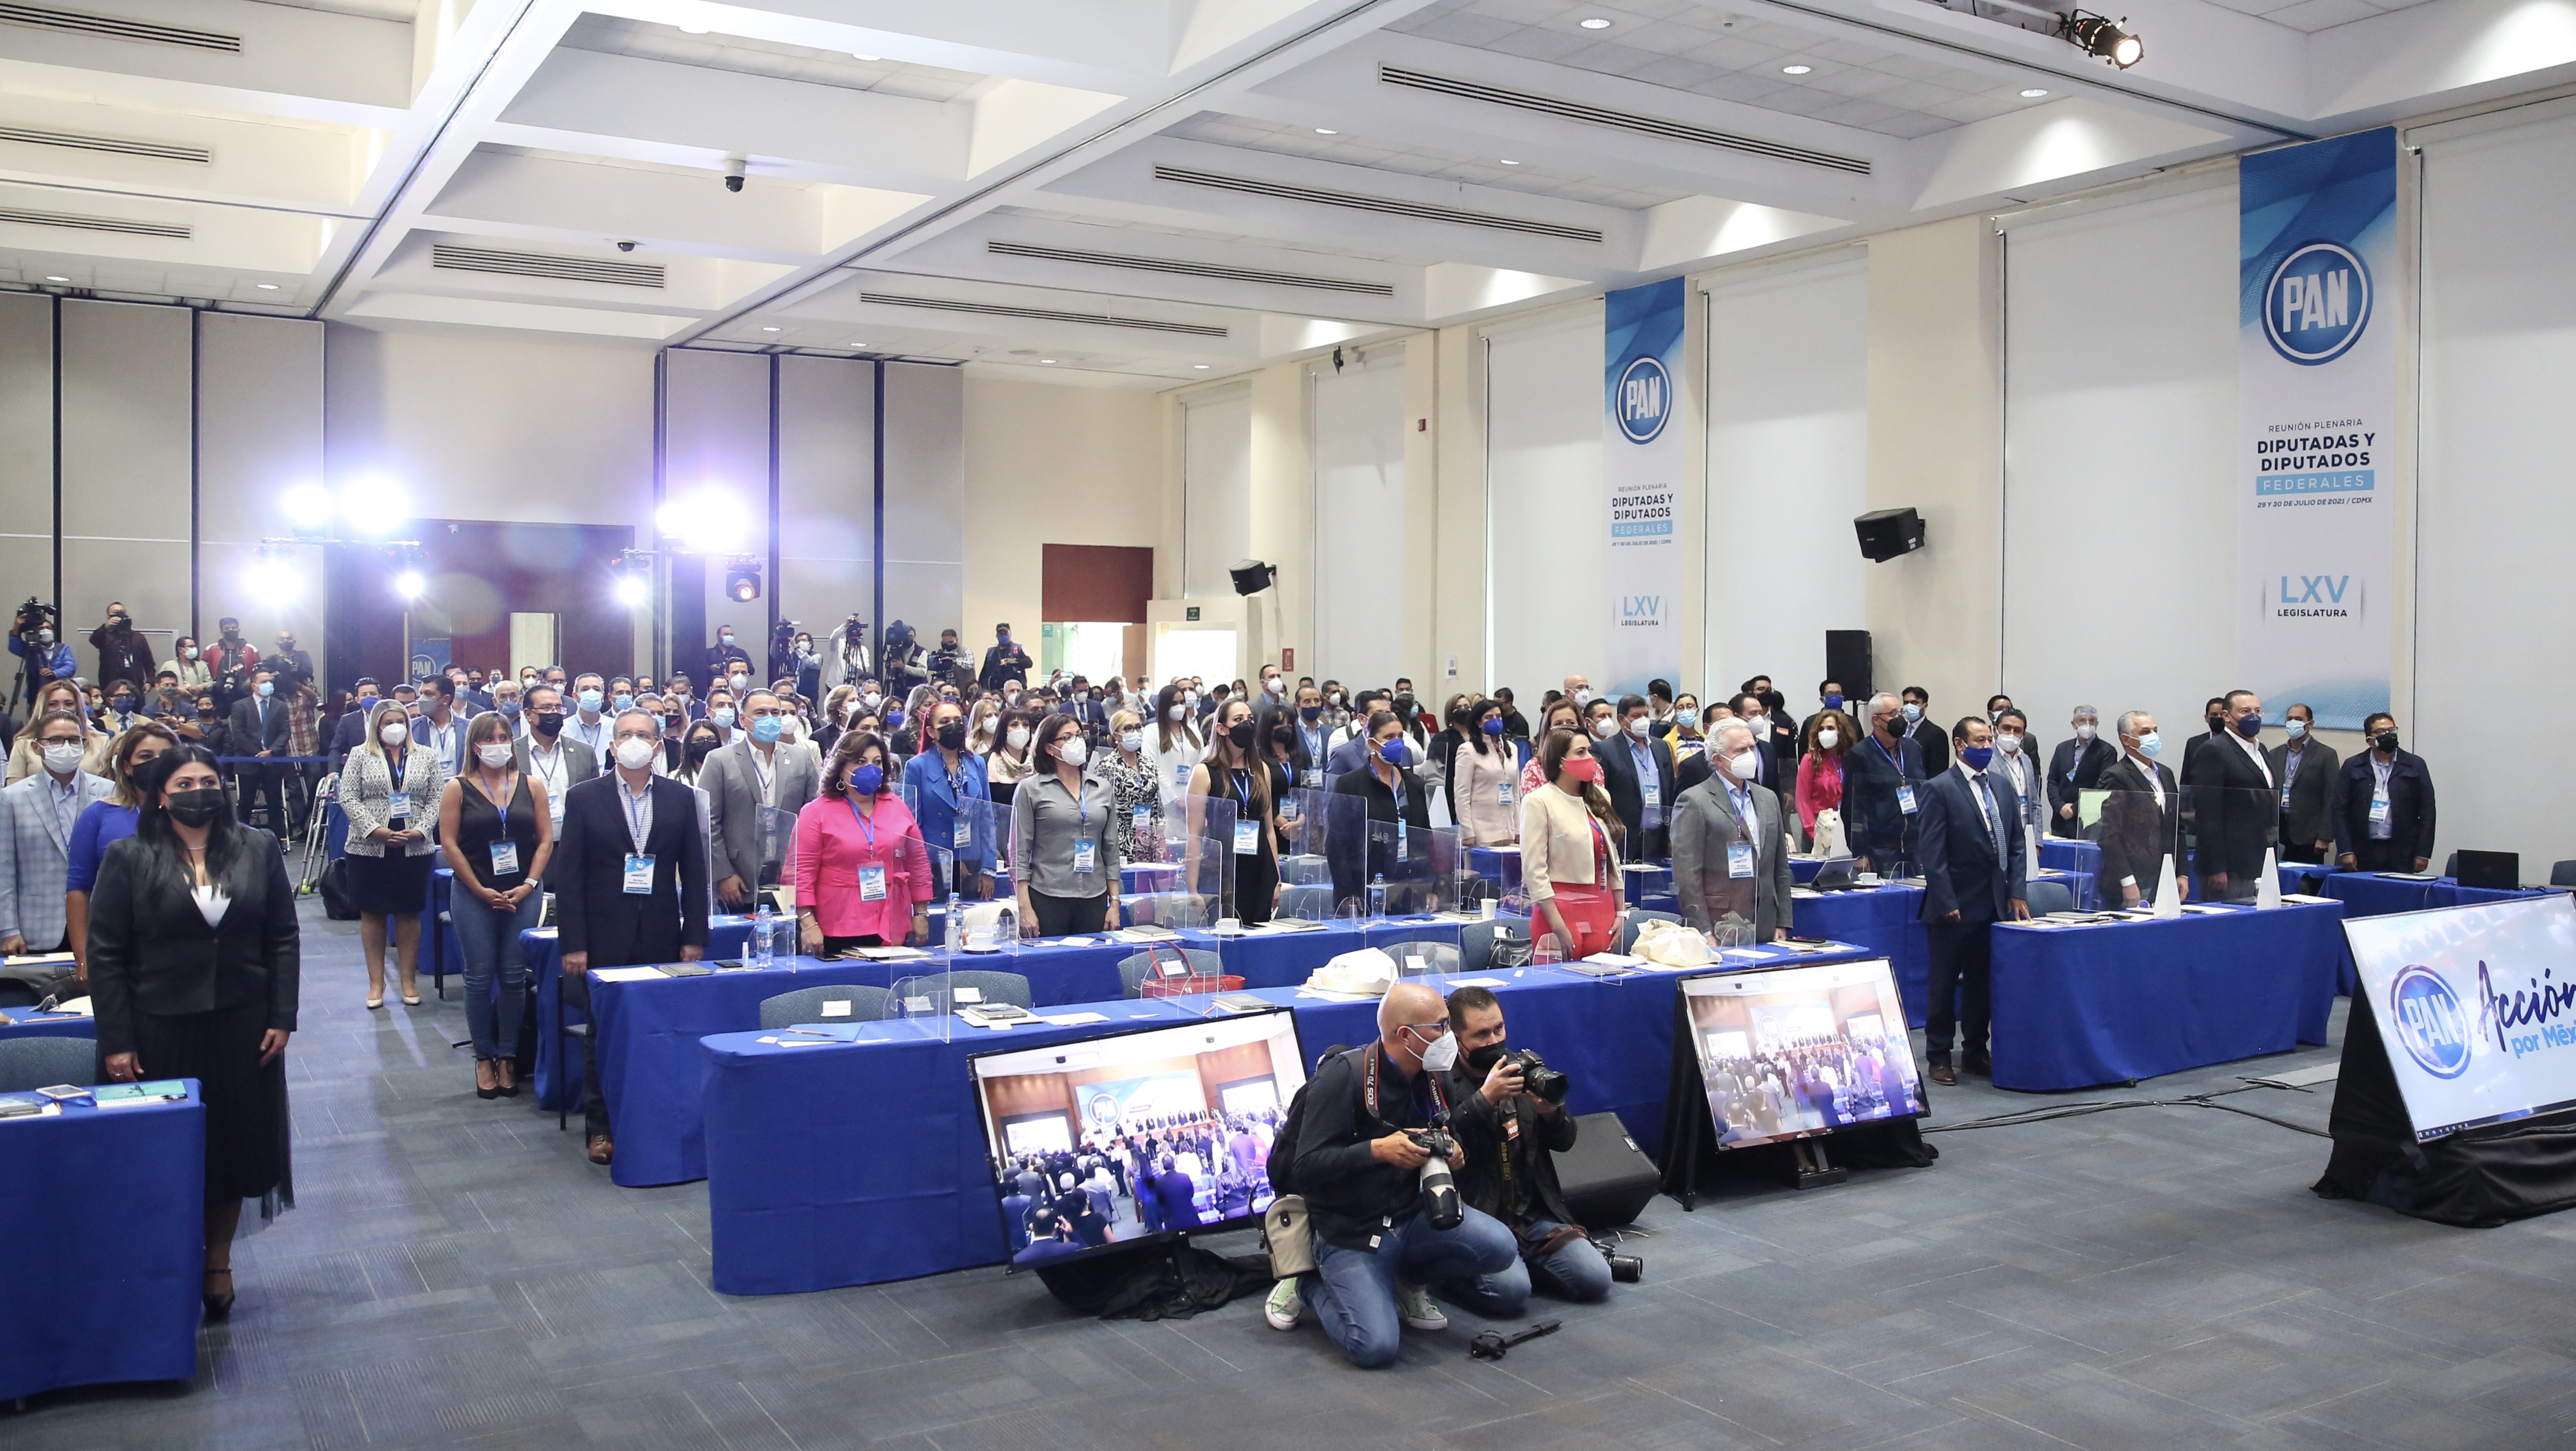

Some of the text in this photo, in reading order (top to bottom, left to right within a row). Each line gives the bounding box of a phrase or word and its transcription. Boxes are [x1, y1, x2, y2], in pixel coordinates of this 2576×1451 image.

[2283, 268, 2348, 333] PAN
[1626, 376, 1661, 421] PAN
[2268, 418, 2363, 433] REUNIÓN PLENARIA
[2257, 432, 2376, 454] DIPUTADAS Y
[2261, 452, 2371, 472] DIPUTADOS
[2263, 475, 2364, 492] FEDERALES
[1612, 493, 1673, 507] DIPUTADAS Y
[1614, 507, 1671, 520] DIPUTADOS
[1615, 523, 1668, 535] FEDERALES
[2281, 575, 2349, 603] LXV
[1623, 595, 1660, 616] LXV
[2277, 609, 2348, 617] LEGISLATURA
[412, 661, 431, 675] PAN
[2402, 993, 2460, 1050] PAN
[2511, 1034, 2540, 1060] por
[1367, 1075, 1374, 1086] 7D
[1500, 1141, 1508, 1162] Nikon
